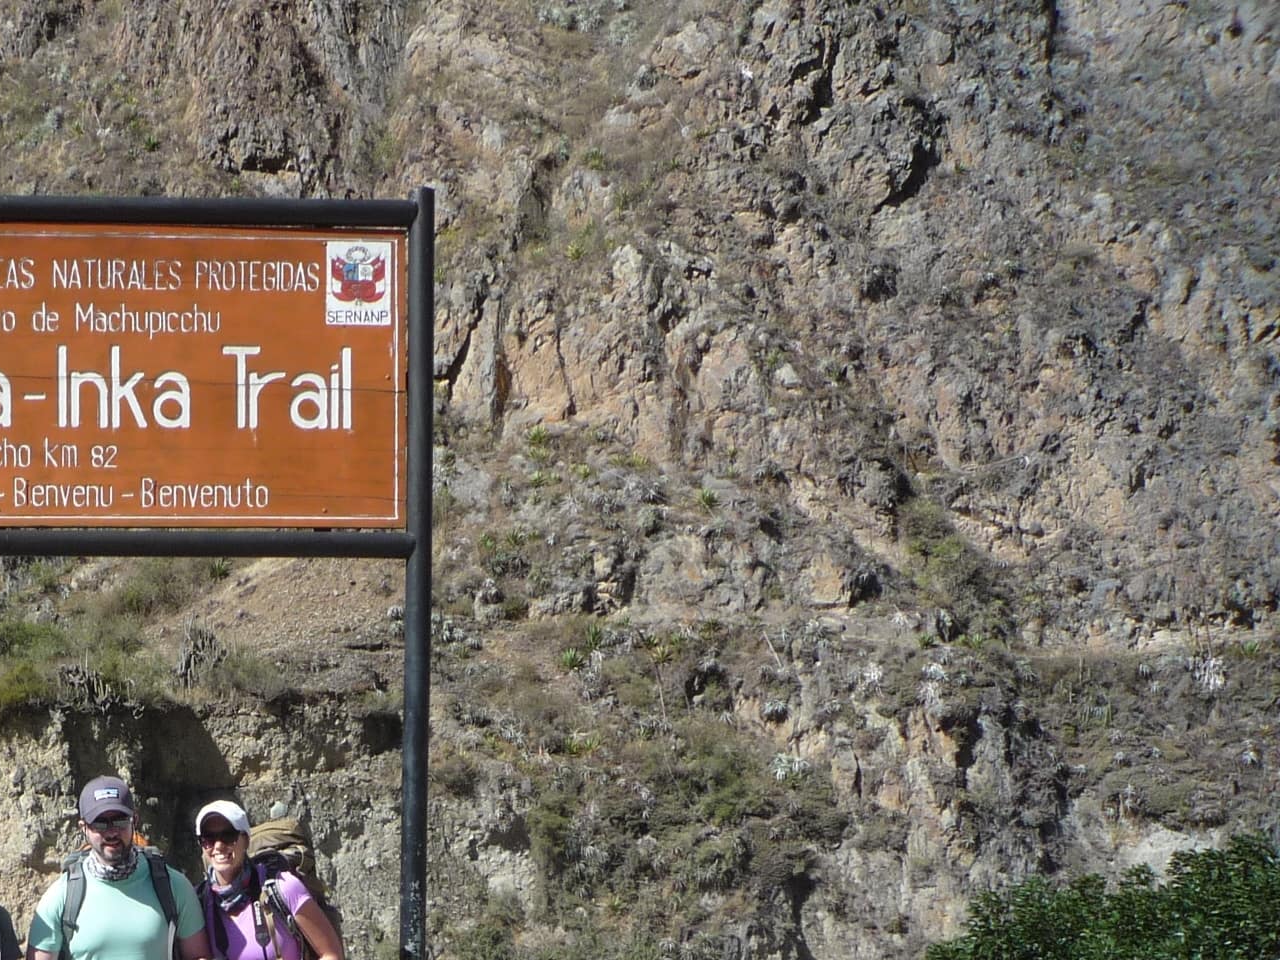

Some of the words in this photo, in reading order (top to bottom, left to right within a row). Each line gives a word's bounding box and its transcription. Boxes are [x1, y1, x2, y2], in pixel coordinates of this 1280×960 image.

[52, 258, 182, 291] NATURALES
[195, 260, 320, 292] PROTEGIDAS
[32, 301, 60, 333] de
[75, 302, 220, 340] Machupicchu
[327, 310, 389, 324] SERNANP
[222, 346, 352, 430] Trail
[44, 436, 78, 468] km
[91, 445, 118, 469] 82
[13, 477, 113, 508] Bienvenu
[141, 477, 269, 509] Bienvenuto
